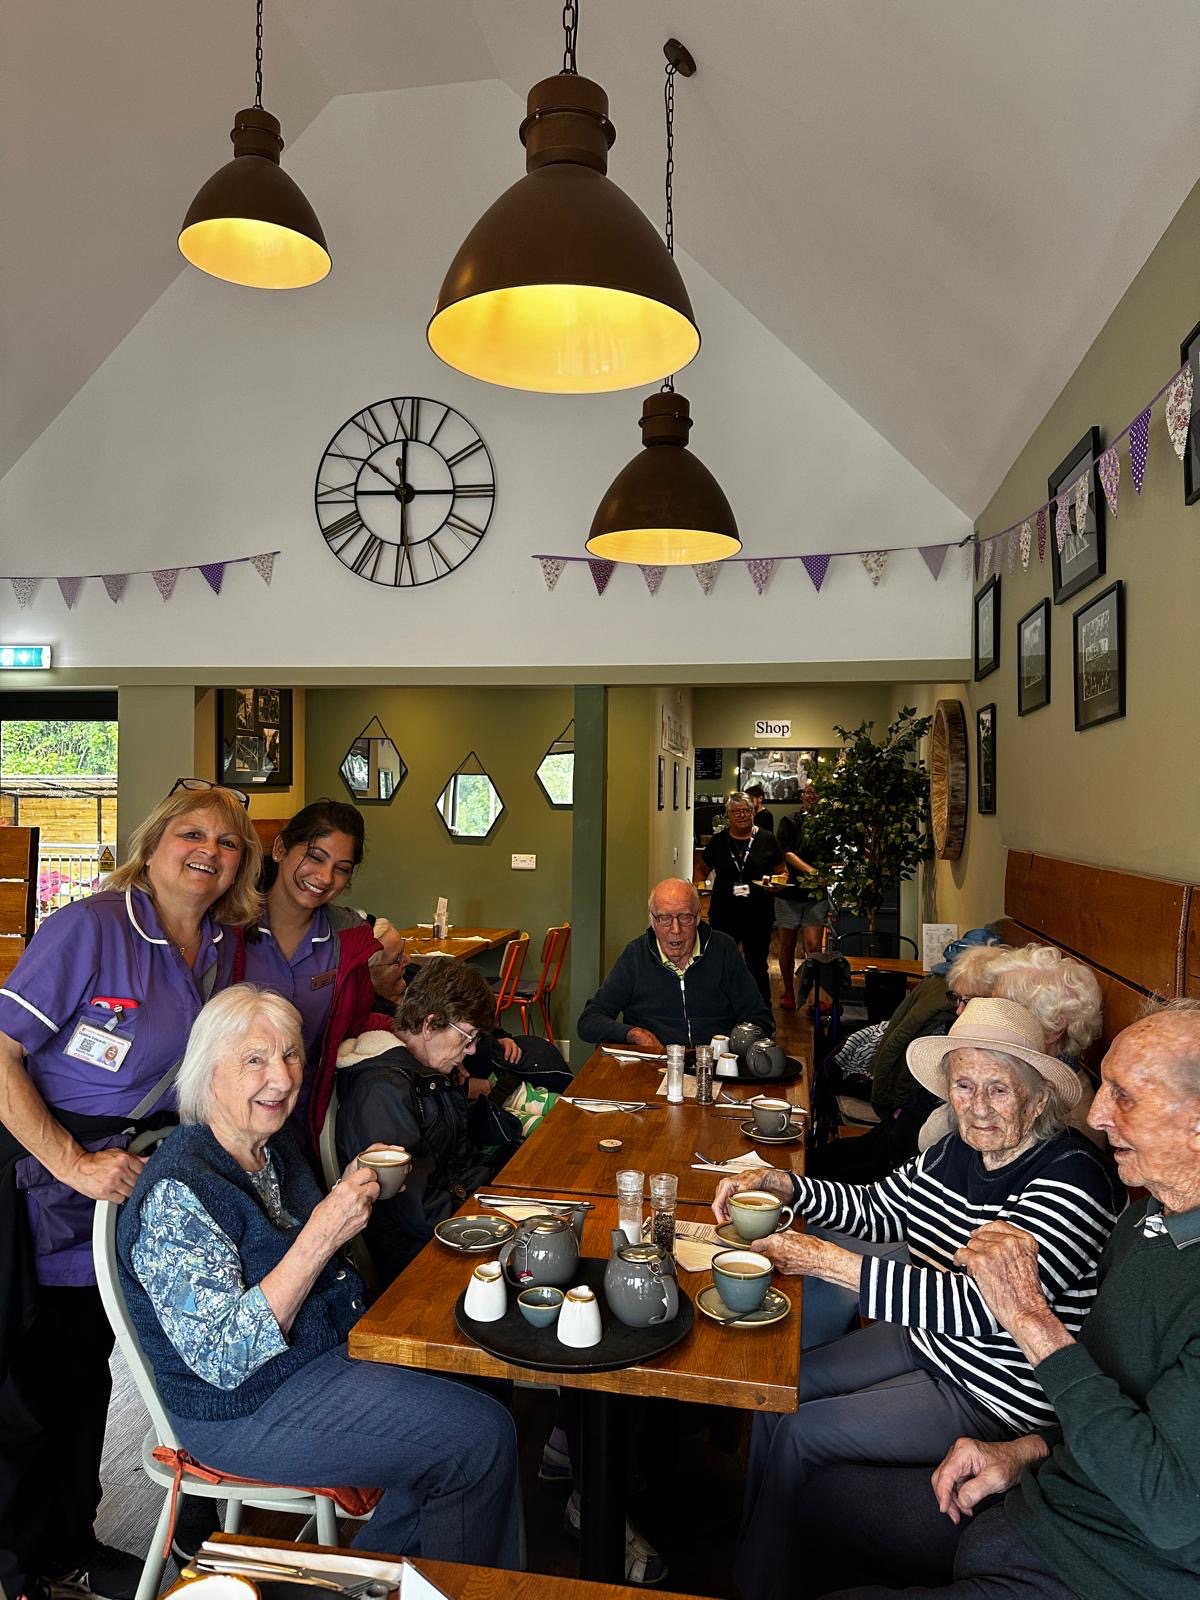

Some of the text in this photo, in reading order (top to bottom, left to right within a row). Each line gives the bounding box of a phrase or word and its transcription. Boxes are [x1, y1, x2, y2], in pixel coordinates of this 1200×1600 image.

[350, 408, 388, 454] XI
[390, 398, 420, 441] XII
[325, 440, 367, 474] X
[445, 438, 486, 468] II
[316, 482, 357, 504] IX
[454, 483, 496, 498] III
[321, 510, 364, 555] VIII
[351, 533, 385, 581] VII
[394, 545, 416, 587] VI
[427, 538, 454, 578] V
[756, 721, 790, 737] Shop
